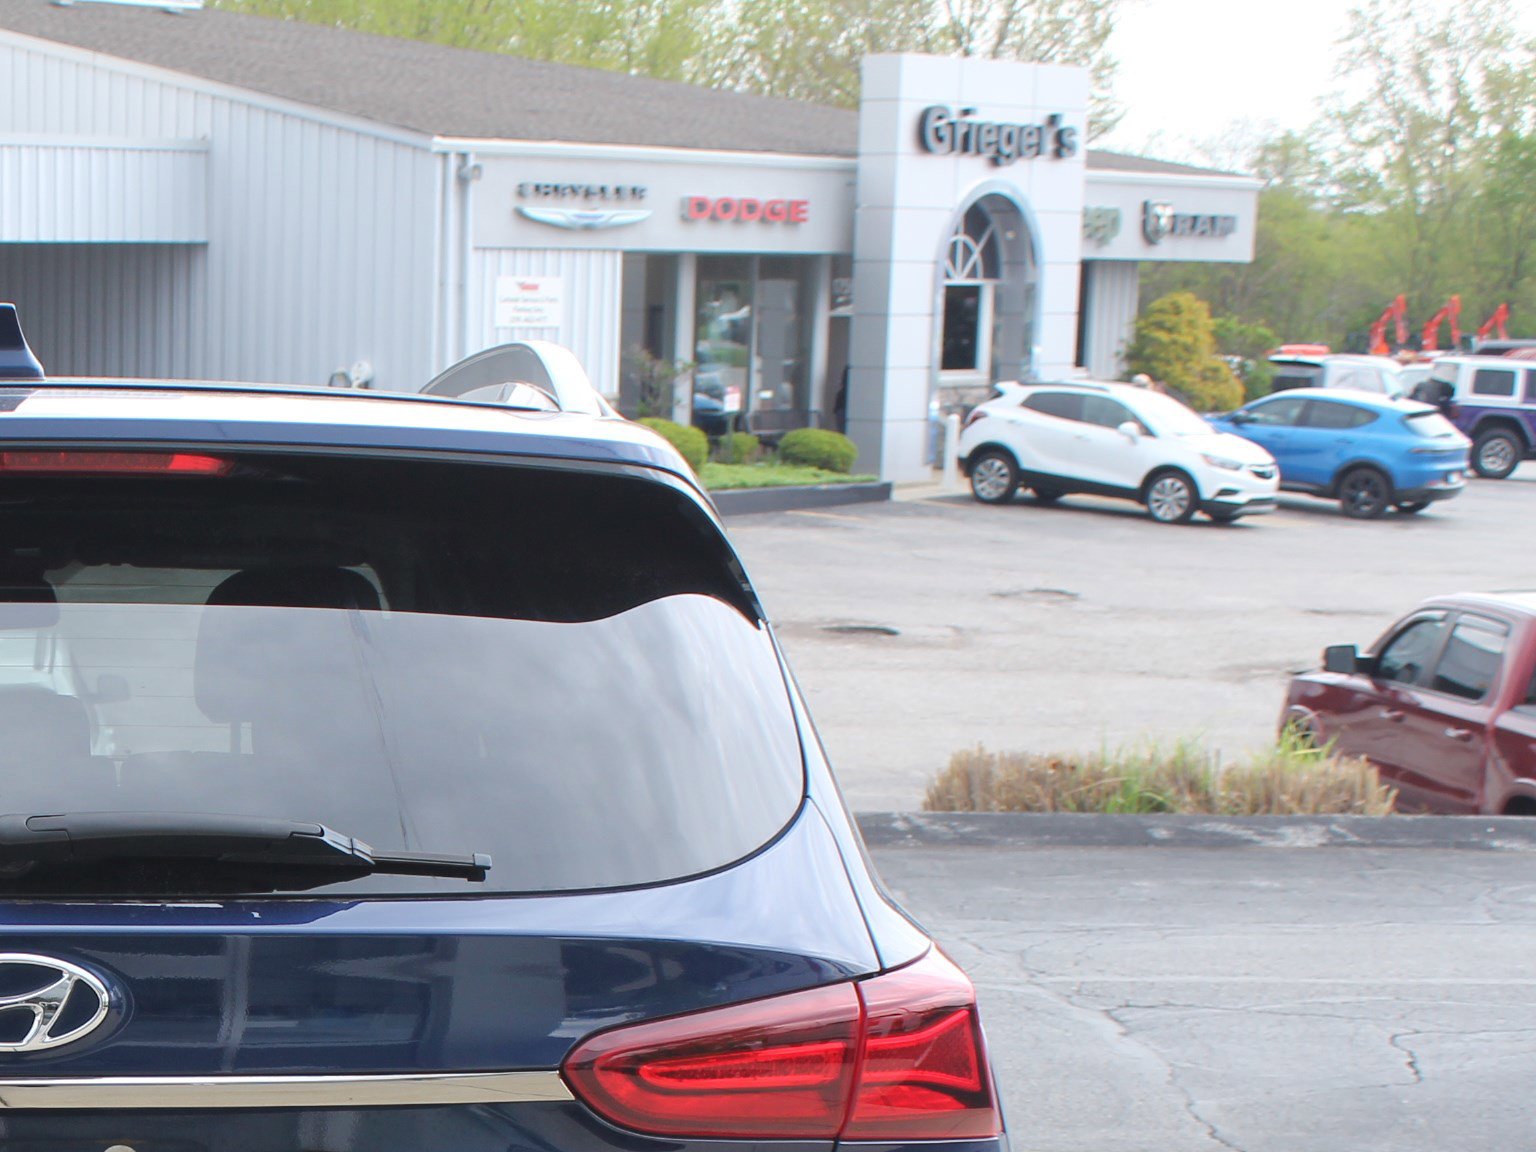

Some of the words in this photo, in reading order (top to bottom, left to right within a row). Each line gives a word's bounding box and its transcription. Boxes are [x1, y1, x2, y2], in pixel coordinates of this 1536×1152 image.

[918, 104, 1077, 167] Grieger's
[683, 196, 810, 223] DODGE
[1170, 213, 1237, 237] RAM
